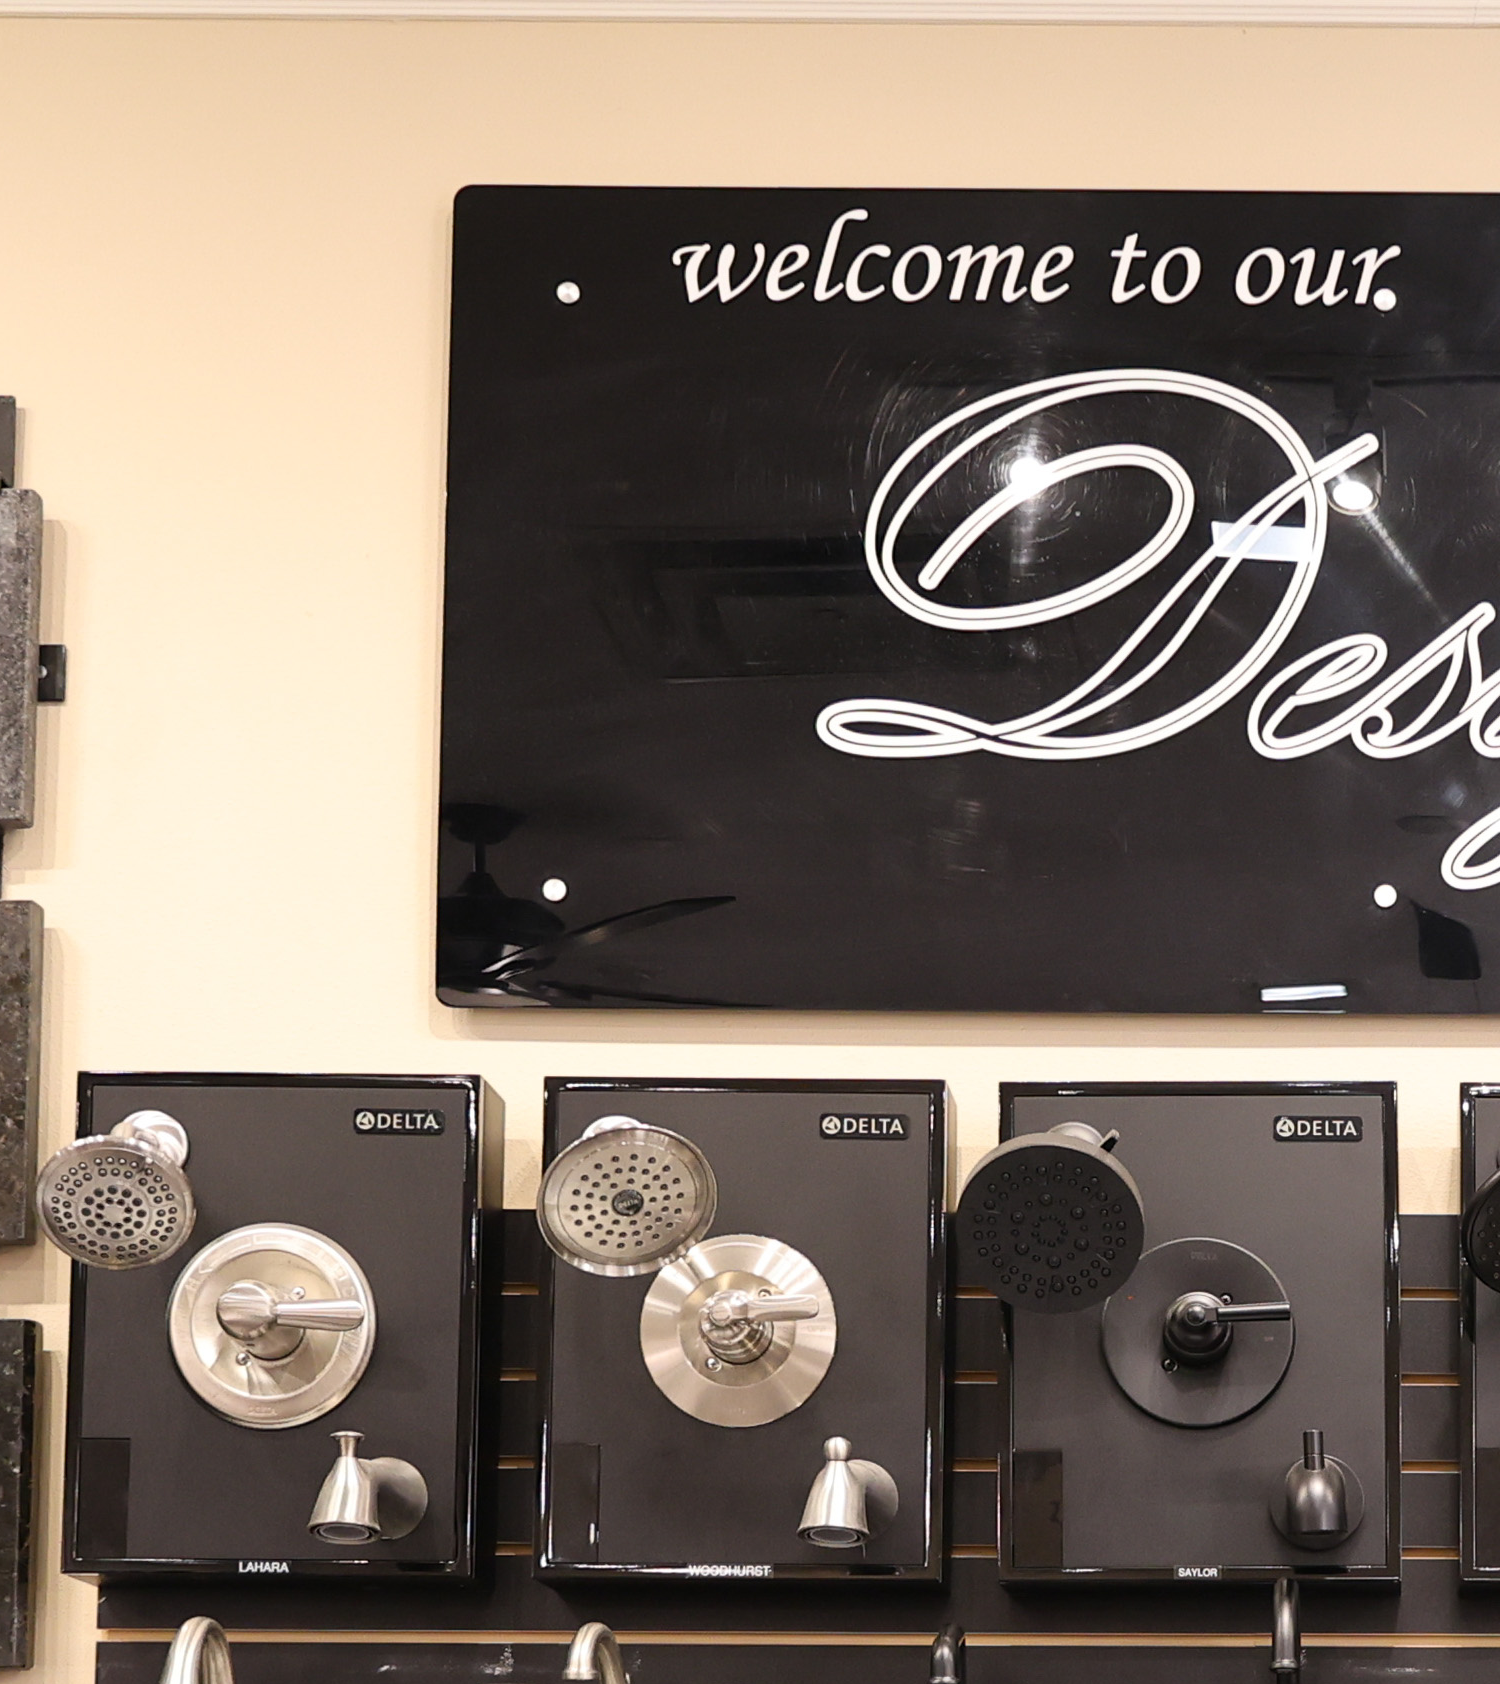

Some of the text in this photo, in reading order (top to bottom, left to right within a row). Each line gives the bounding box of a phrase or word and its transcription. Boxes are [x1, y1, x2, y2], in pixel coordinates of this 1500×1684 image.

[672, 209, 1075, 304] welcome
[1110, 233, 1202, 304] to
[377, 1112, 438, 1130] DELTA
[843, 1117, 904, 1135] DELTA
[1297, 1120, 1357, 1137] DELTA
[238, 1561, 290, 1574] LAHARA
[689, 1564, 771, 1577] WOODHURST
[1178, 1567, 1219, 1578] SAYLOR
